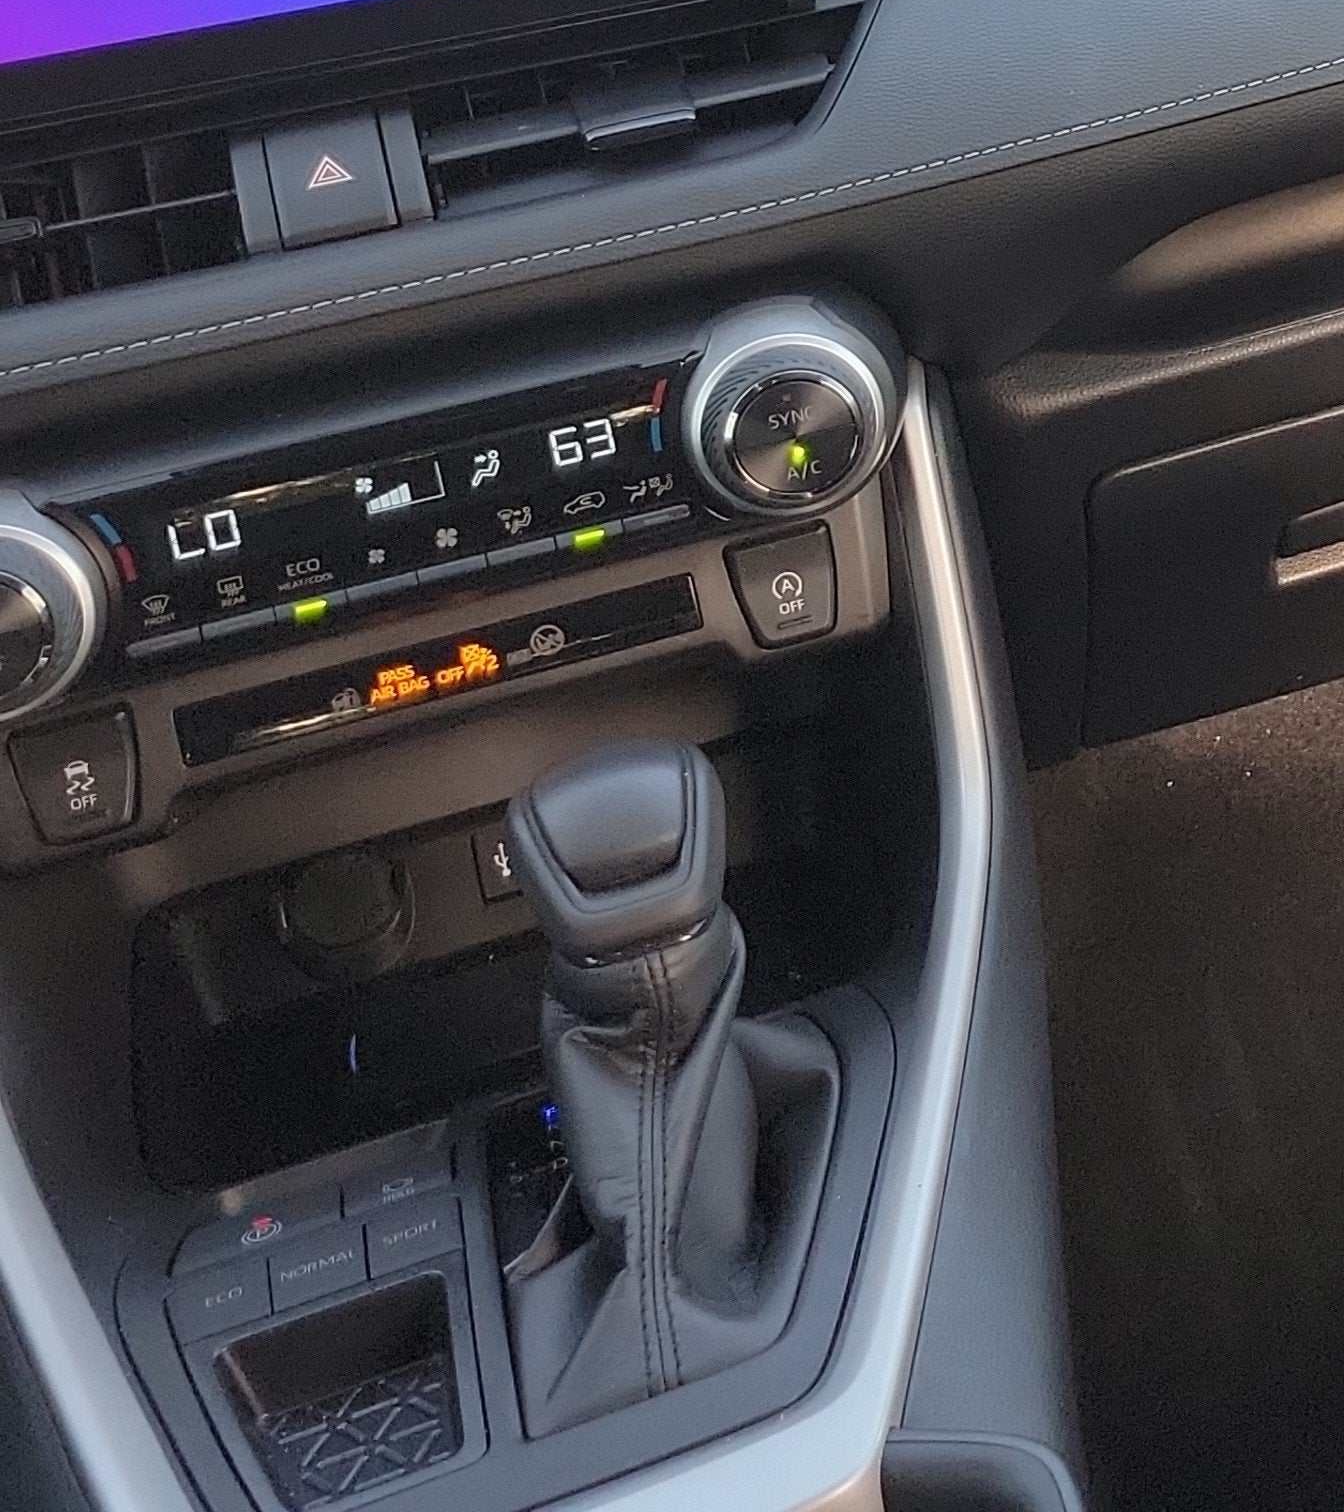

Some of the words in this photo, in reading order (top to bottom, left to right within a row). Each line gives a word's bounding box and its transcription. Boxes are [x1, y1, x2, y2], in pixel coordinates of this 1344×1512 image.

[768, 405, 815, 431] SYNC
[549, 417, 617, 467] 63
[786, 459, 822, 483] A/C
[285, 557, 321, 578] ECO
[277, 571, 335, 594] HEAT/COOL
[779, 598, 806, 615] OFF
[370, 685, 398, 706] AIR
[398, 675, 431, 696] BAG
[436, 665, 465, 684] OFF
[378, 664, 416, 686] PASS
[70, 793, 98, 811] OFF
[382, 1218, 437, 1246] SPORT
[279, 1249, 355, 1283] NORMAL
[205, 1287, 243, 1308] ECO
